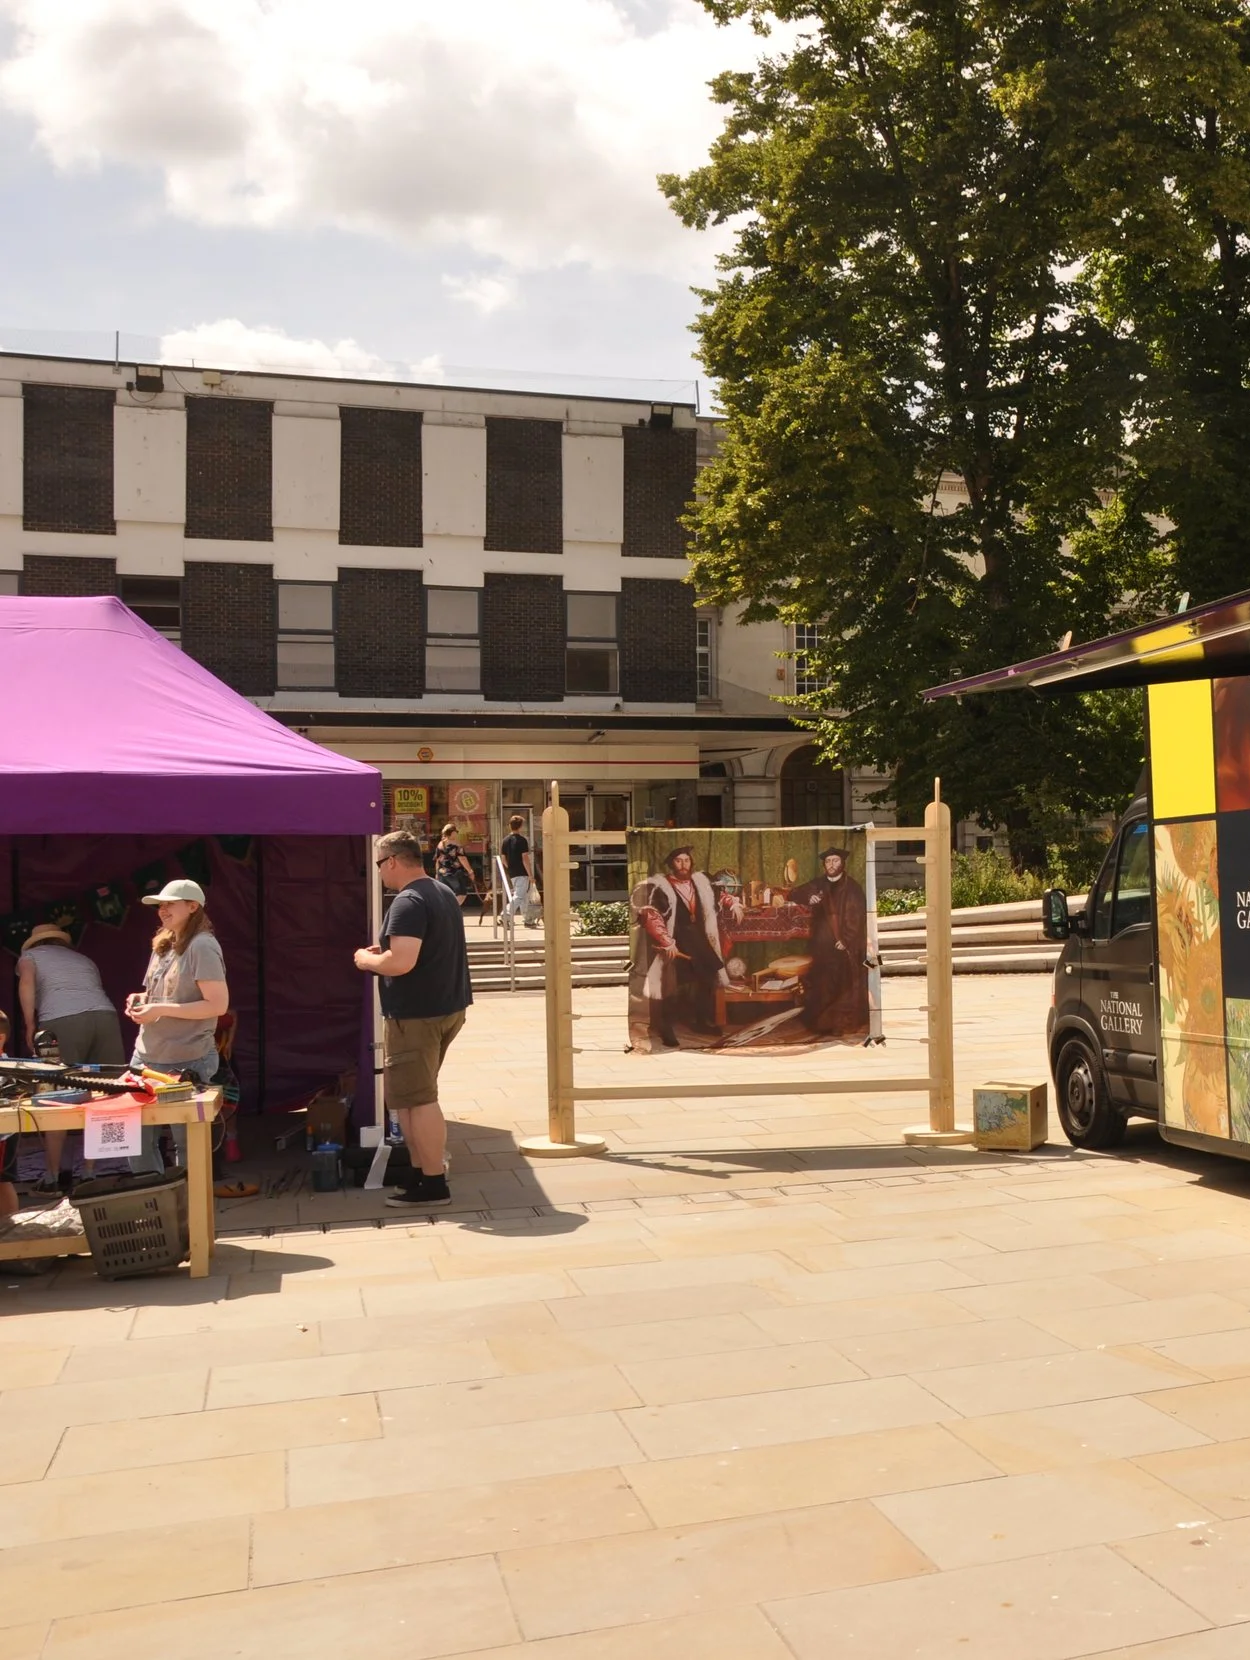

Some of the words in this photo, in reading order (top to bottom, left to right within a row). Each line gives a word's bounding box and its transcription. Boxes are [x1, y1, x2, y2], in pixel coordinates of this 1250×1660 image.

[397, 789, 423, 801] 10%
[1110, 991, 1119, 999] THE
[1100, 999, 1143, 1017] NATIONAL
[1100, 1014, 1143, 1036] GALLERY
